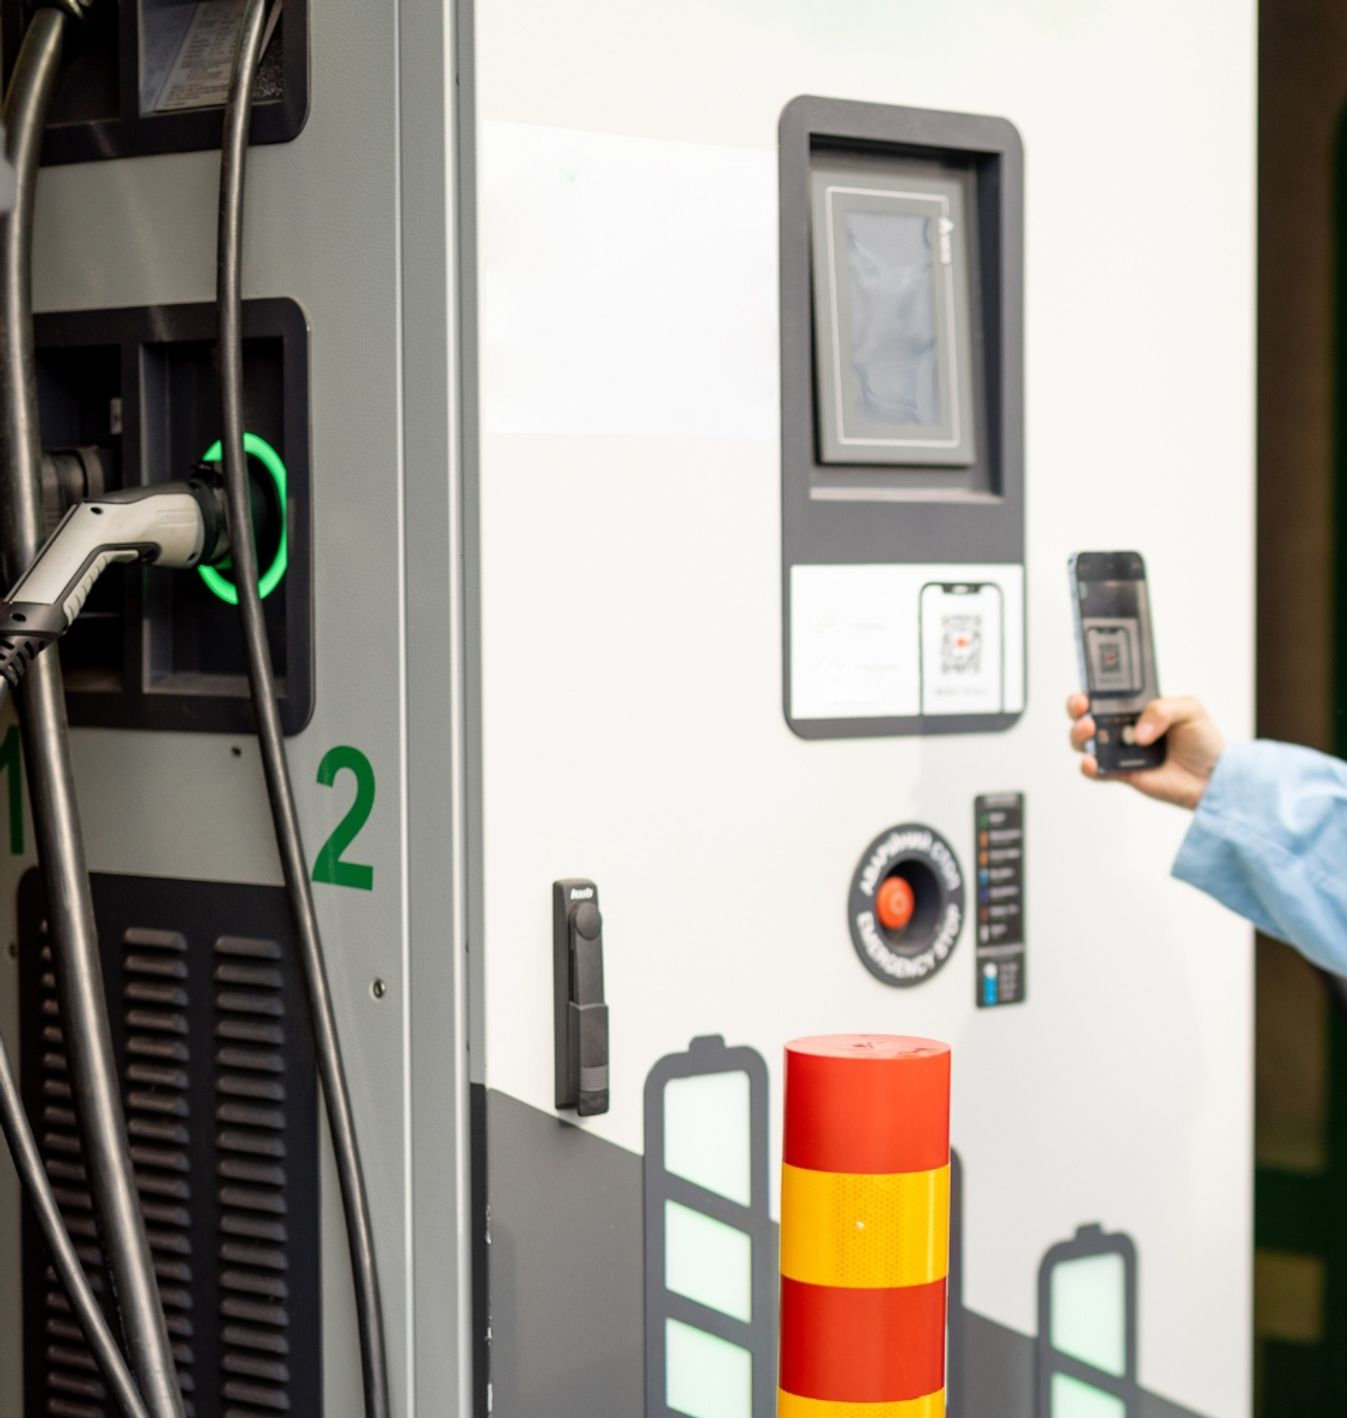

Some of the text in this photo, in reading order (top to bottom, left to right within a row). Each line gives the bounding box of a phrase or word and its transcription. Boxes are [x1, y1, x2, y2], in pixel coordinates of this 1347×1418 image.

[312, 745, 376, 891] 2
[857, 903, 960, 978] EMERGENCY STOP
